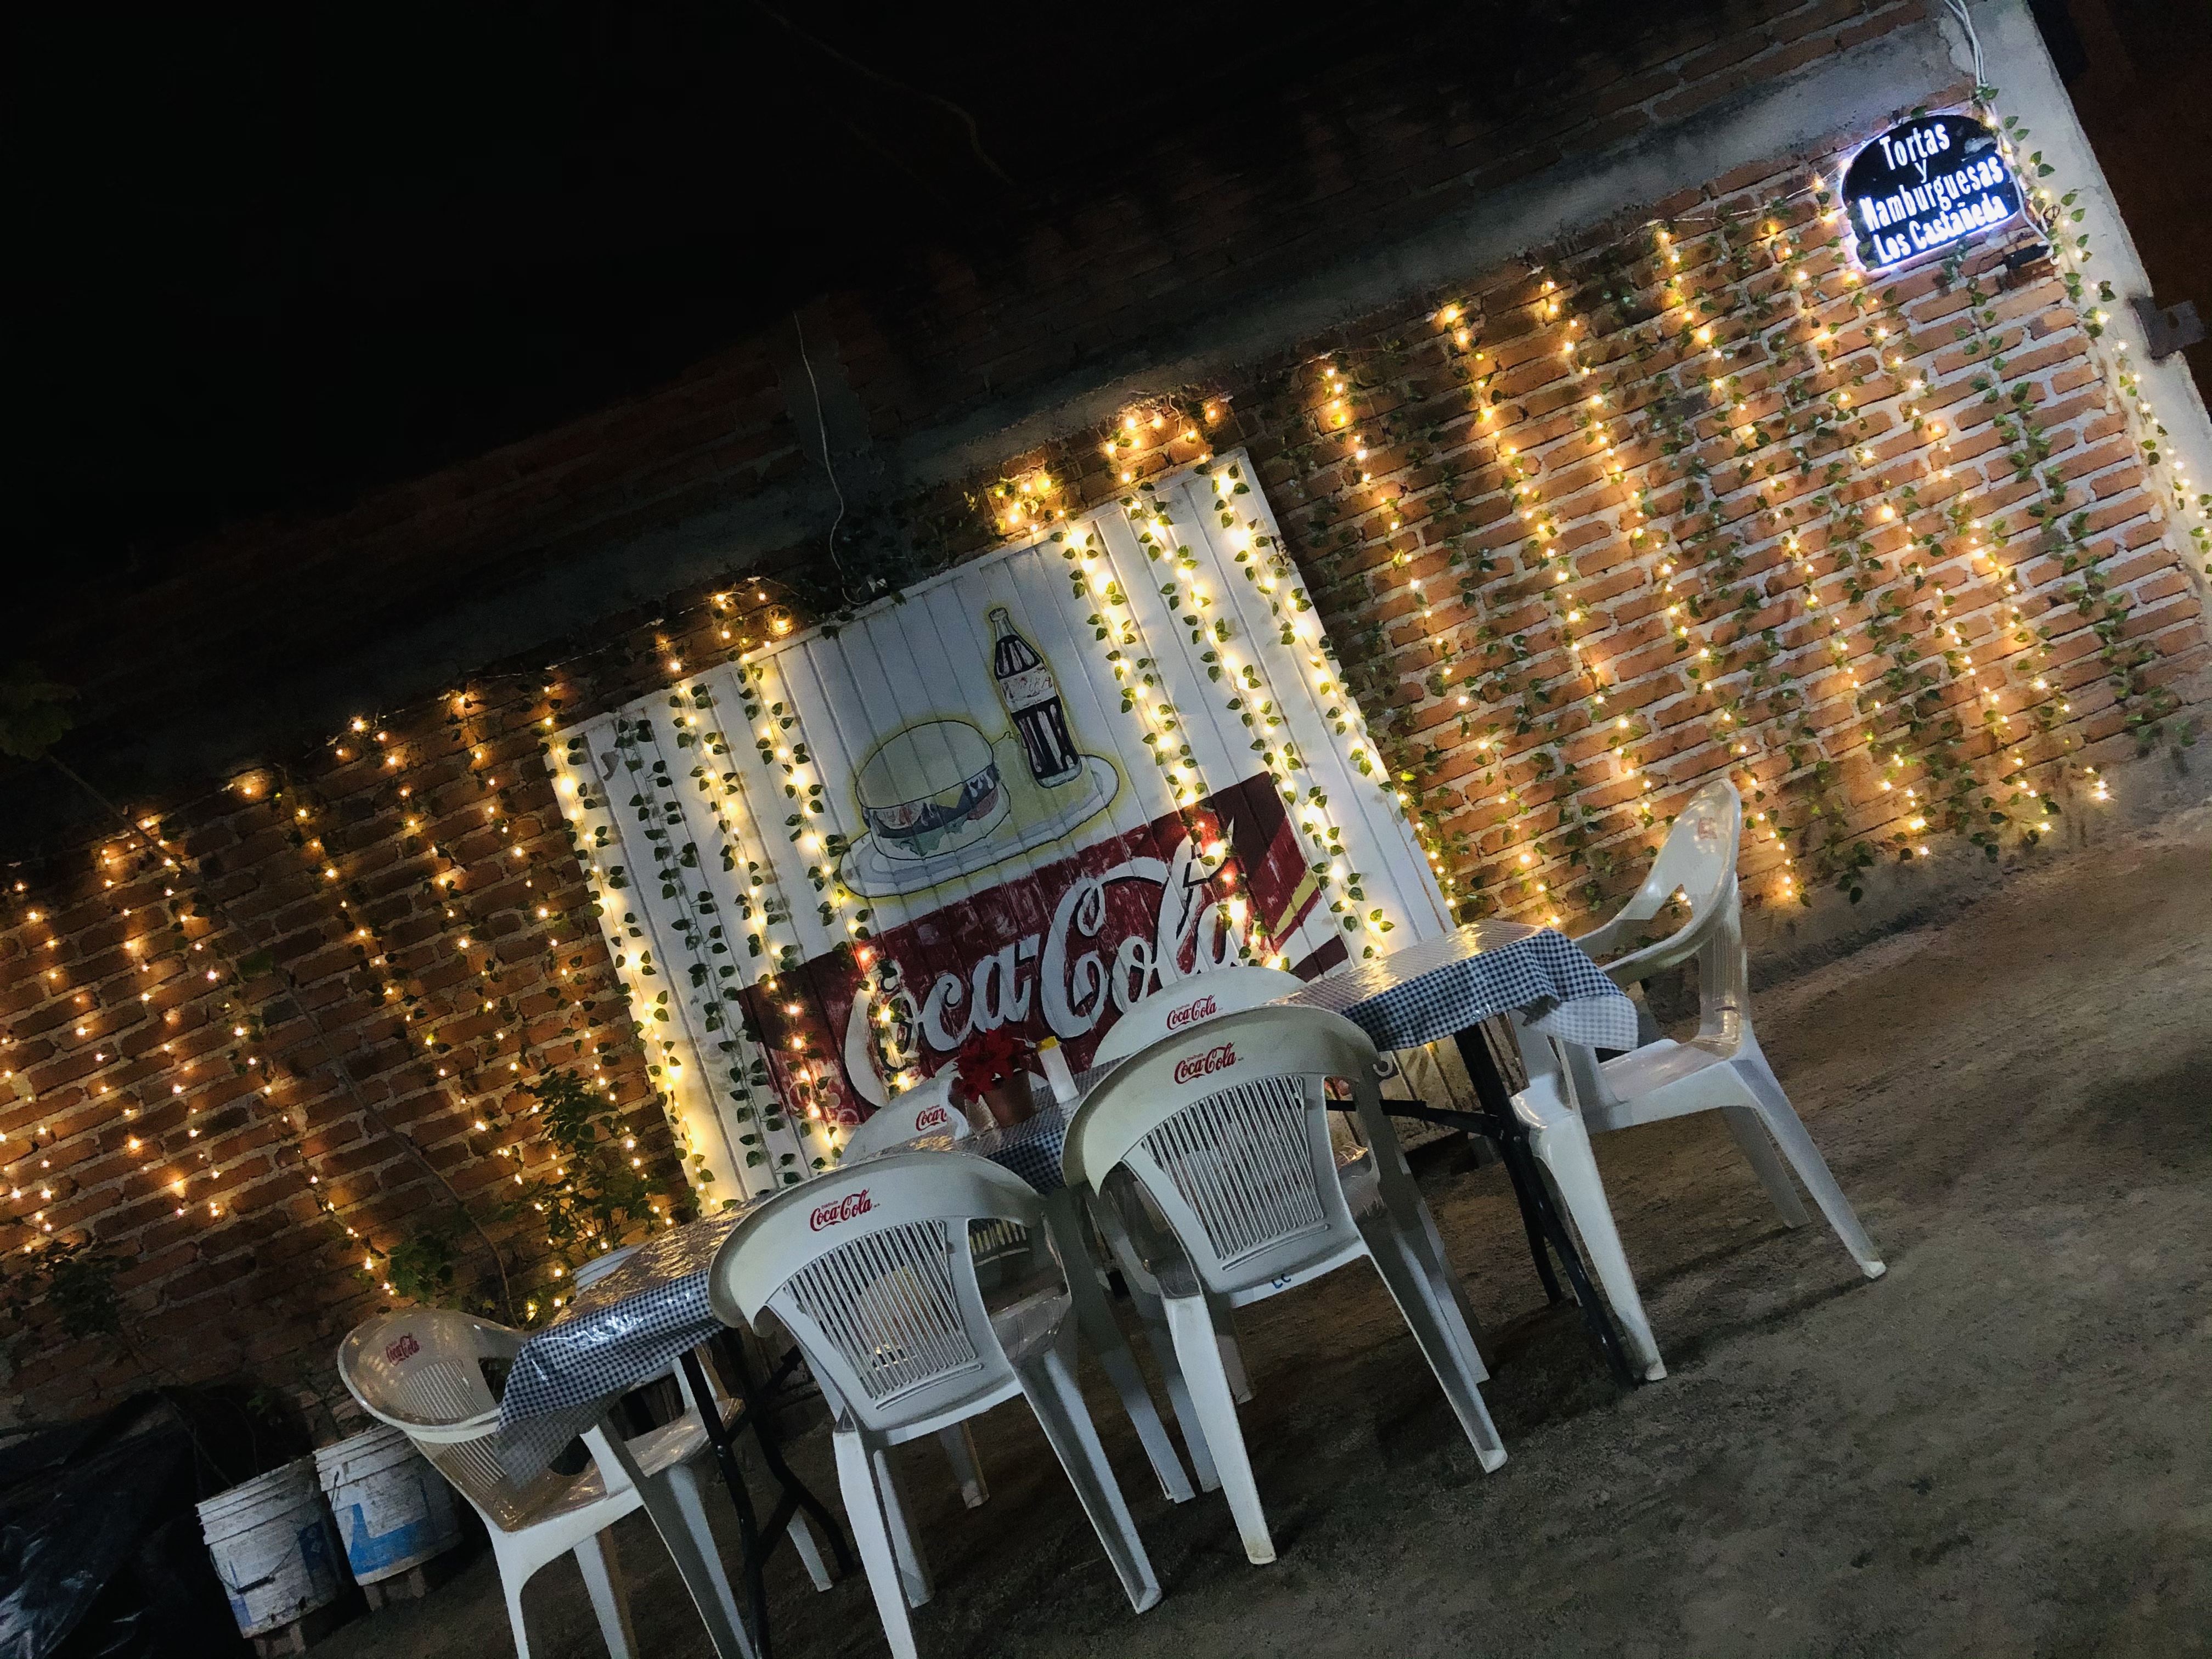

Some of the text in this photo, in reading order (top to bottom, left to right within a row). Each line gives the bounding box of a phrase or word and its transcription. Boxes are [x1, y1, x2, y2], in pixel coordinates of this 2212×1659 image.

[1880, 123, 1950, 171] Tortas
[1914, 159, 1927, 183] y
[1859, 155, 2004, 233] Hamburguesas
[1873, 193, 2008, 264] Los Castañeda
[1166, 994, 1217, 1030] Coca-Cola
[1174, 1042, 1237, 1084] Coca-Cola
[810, 1187, 873, 1232] Coca-Cola
